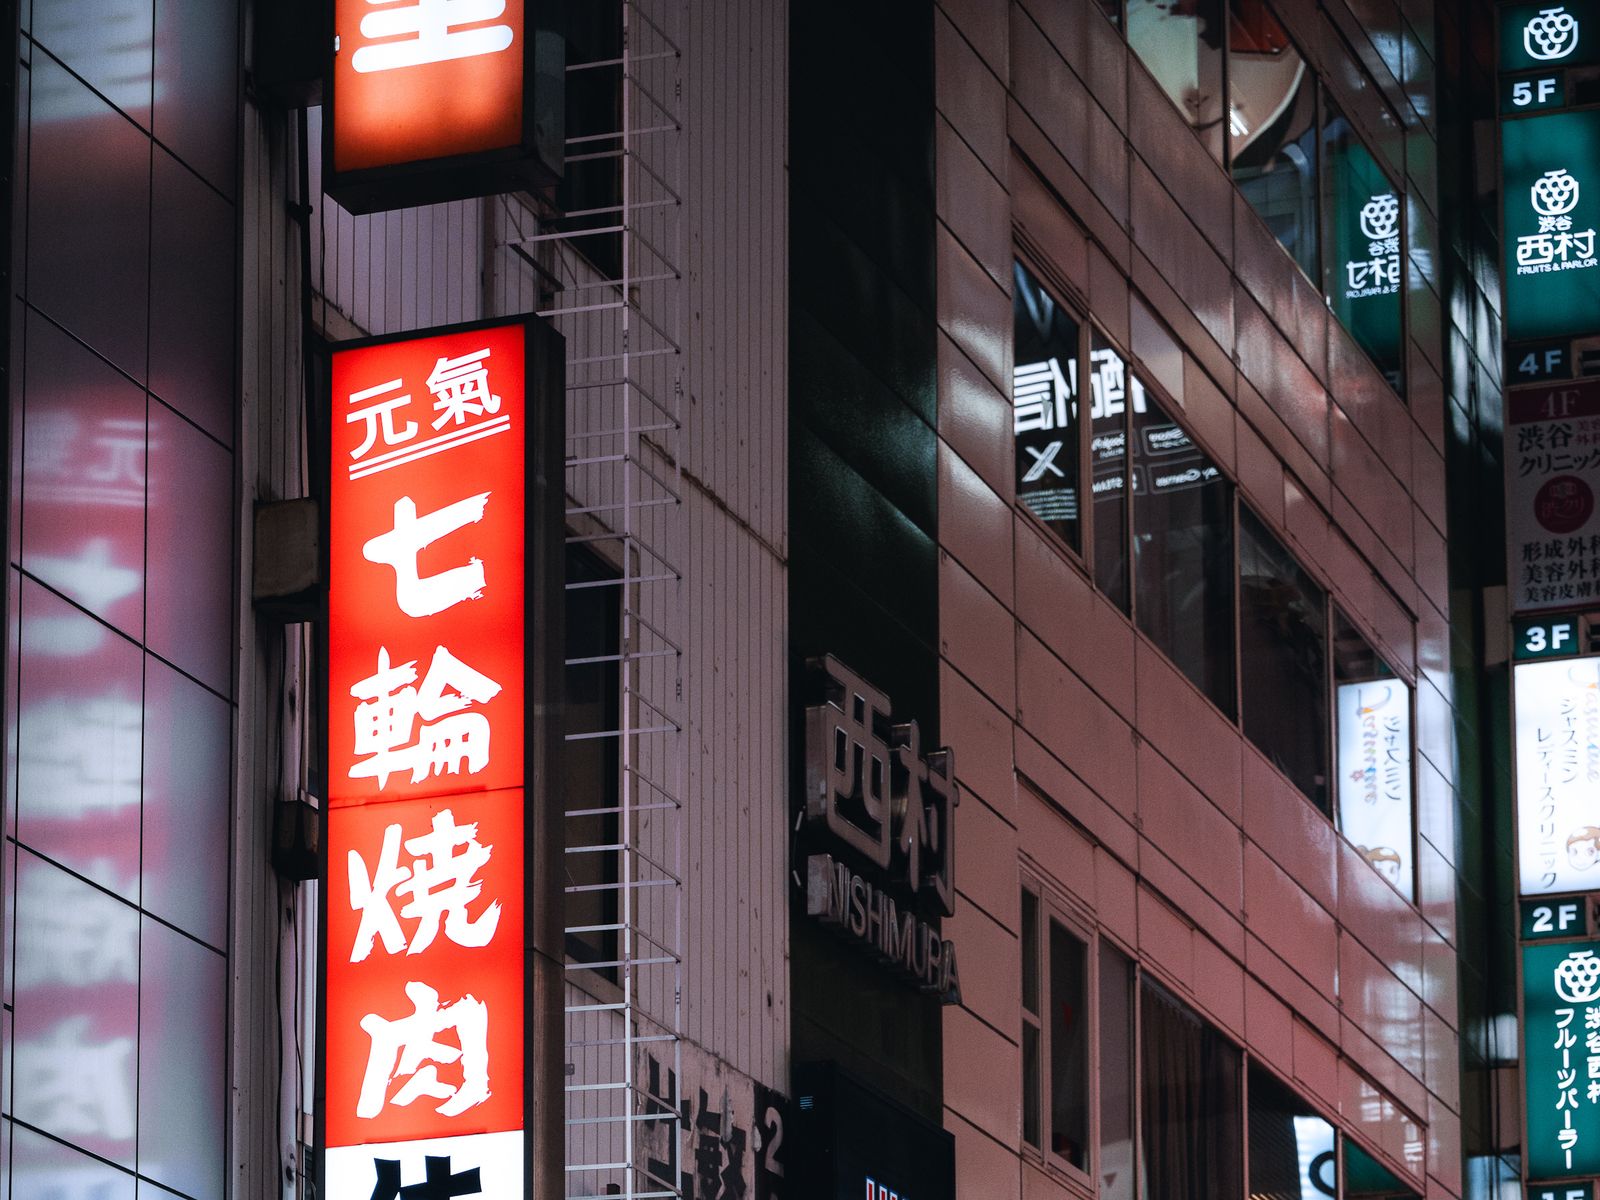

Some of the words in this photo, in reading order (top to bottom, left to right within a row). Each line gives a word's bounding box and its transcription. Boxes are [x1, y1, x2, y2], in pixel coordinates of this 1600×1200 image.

[1512, 78, 1557, 106] 5F
[1516, 228, 1597, 266] 西村
[1519, 349, 1561, 375] 4F
[346, 347, 502, 463] 元氣
[1517, 422, 1573, 452] 渋谷
[1526, 623, 1571, 652] 3F
[349, 491, 503, 1119] 七輪焼肉
[826, 852, 962, 1006] NISHIMURA
[1532, 904, 1578, 933] 2F
[1554, 1007, 1581, 1170] フルーツパーラー
